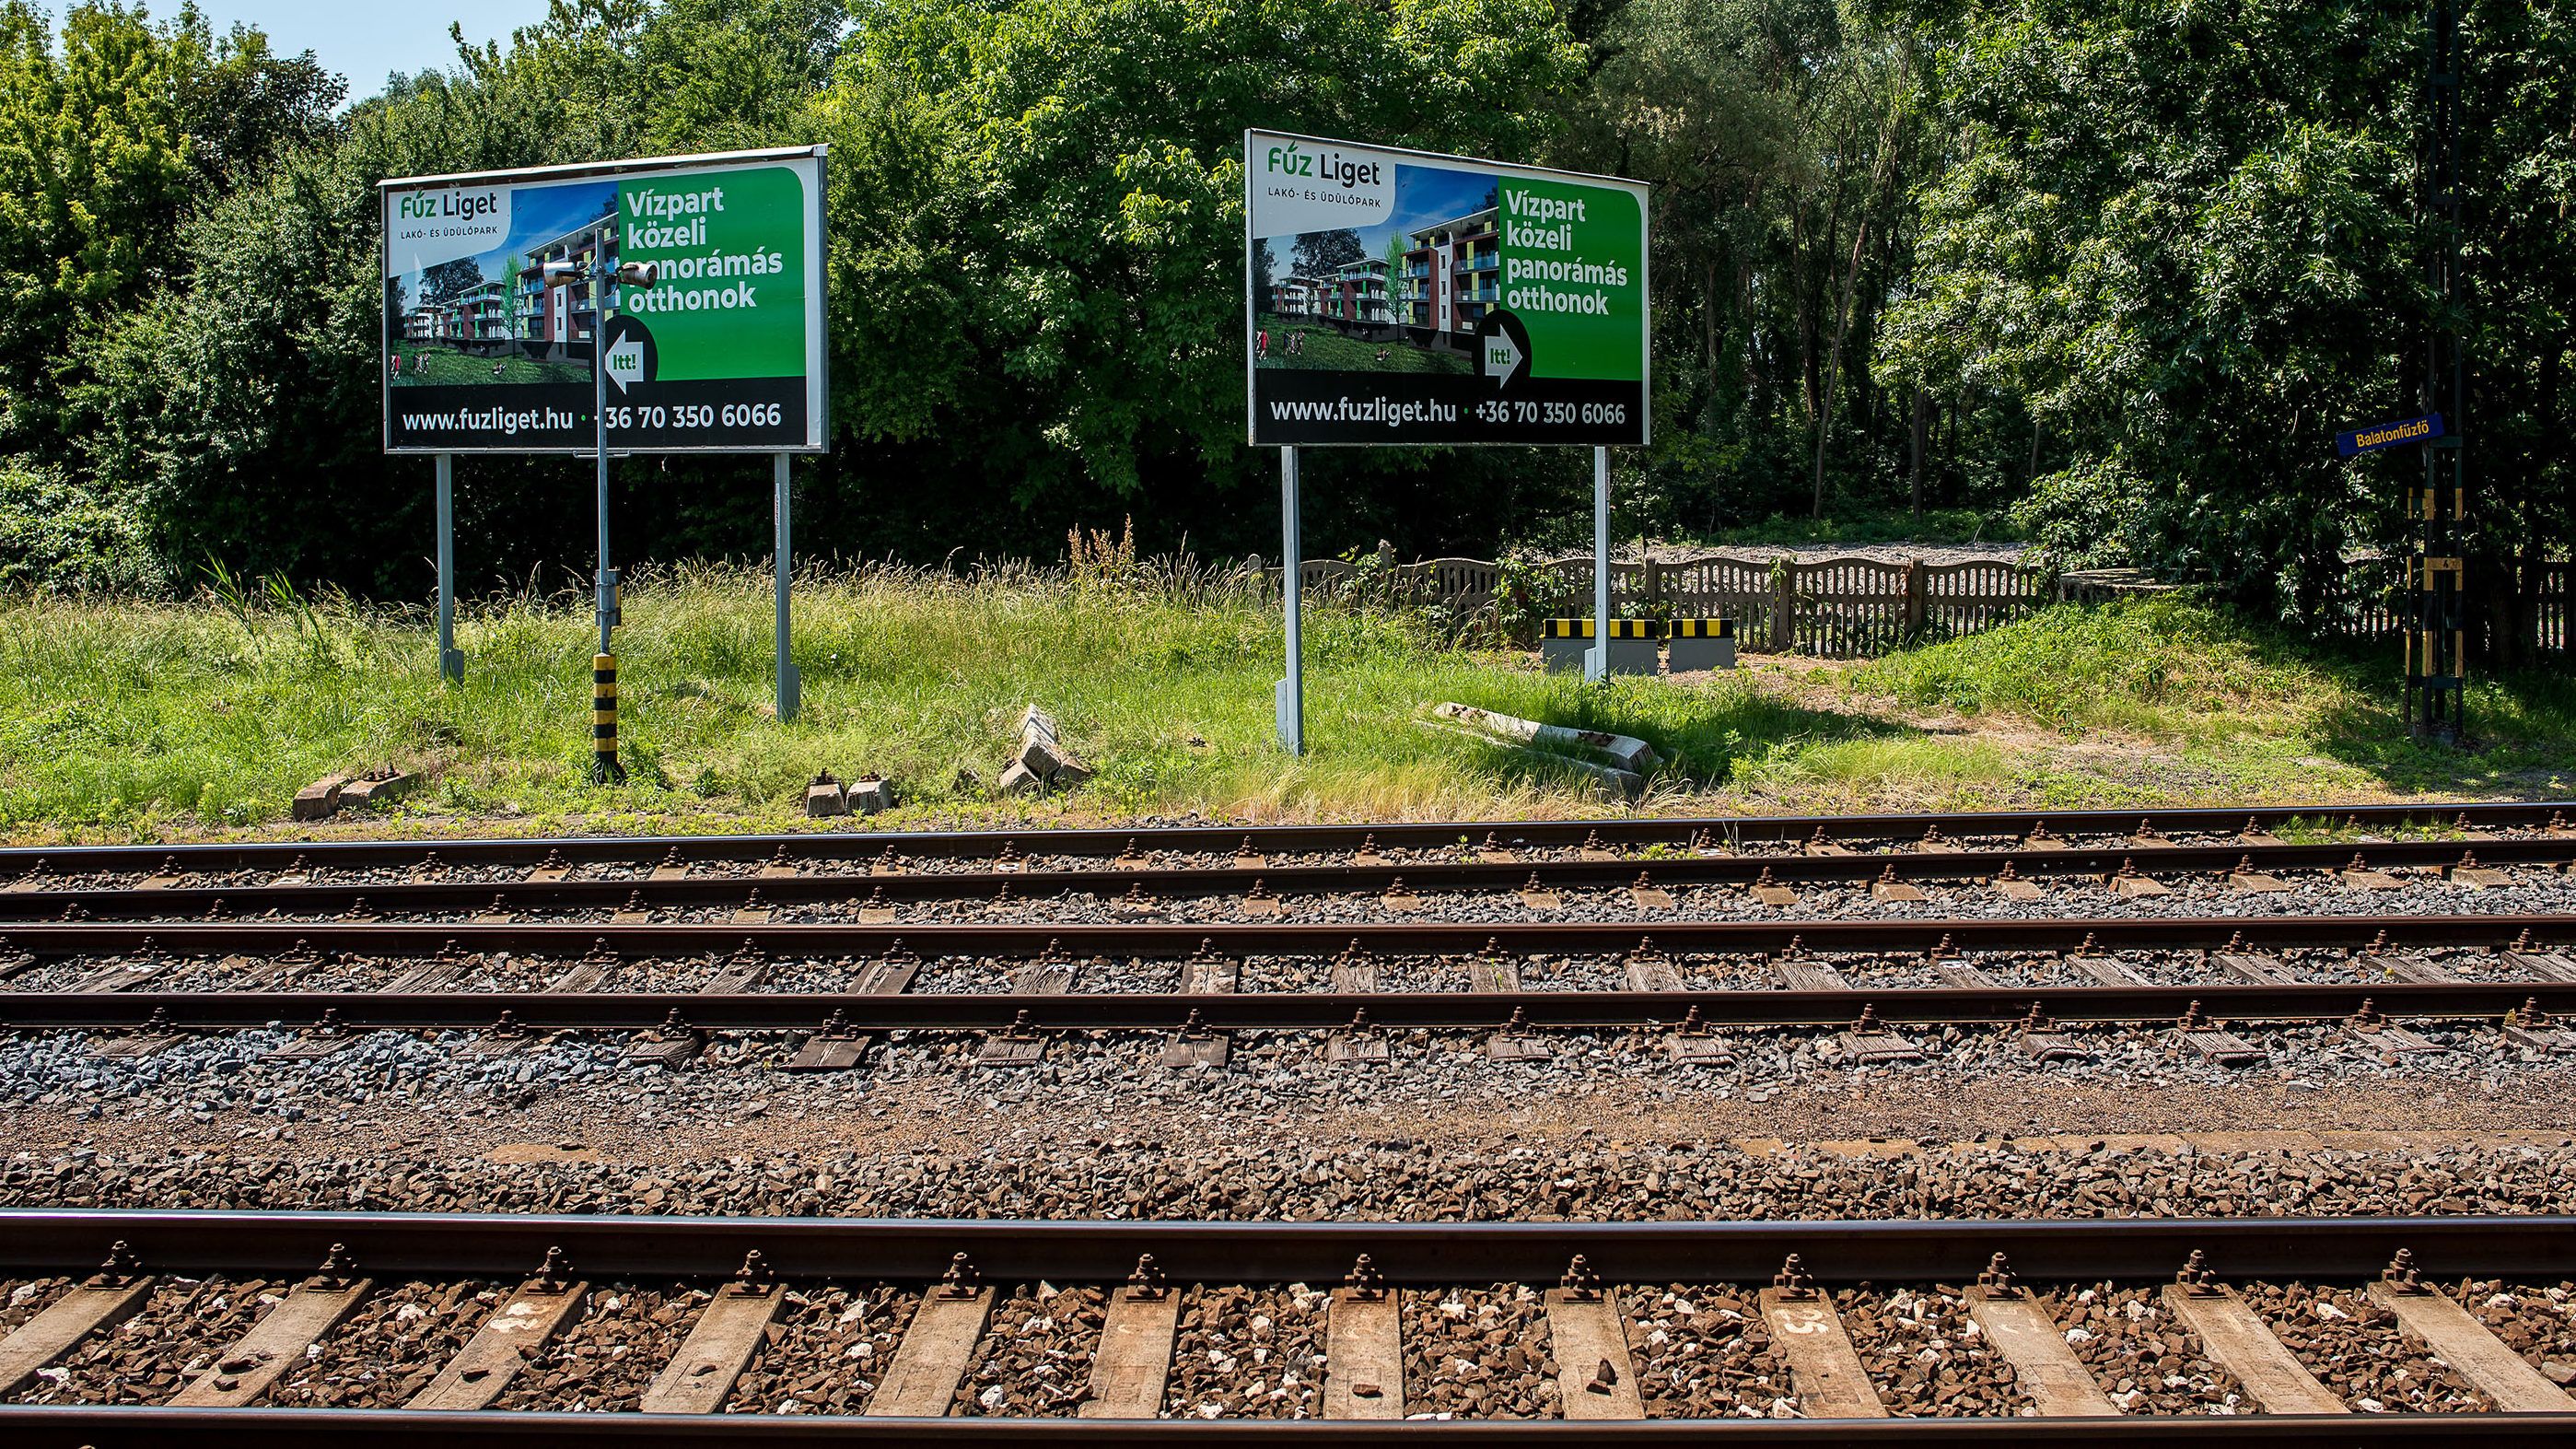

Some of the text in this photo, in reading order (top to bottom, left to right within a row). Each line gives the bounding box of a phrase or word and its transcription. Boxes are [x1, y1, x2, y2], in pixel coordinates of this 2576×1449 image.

[1320, 153, 1381, 188] Liget
[443, 191, 497, 221] Liget
[626, 187, 725, 221] Vízpart
[1268, 187, 1381, 208] LAKÓ- ÉS ÜDÜLŐPARK
[1505, 189, 1586, 224] Vízpart
[401, 226, 498, 240] LAKÓ- ÉS ÜDÜLŐPARK
[628, 216, 706, 250] közeli
[1507, 219, 1571, 251] közeli
[629, 246, 783, 287] norámás
[1507, 256, 1627, 286] panorámás
[628, 281, 757, 313] otthonok
[1507, 285, 1609, 315] otthonok
[612, 353, 637, 370] Itt!
[1489, 347, 1511, 365] Itt!
[402, 403, 782, 435] www.fuzliget.hu 36 70 350 6066
[1270, 396, 1626, 427] www.fuzliget.hu +36 70 350 6066
